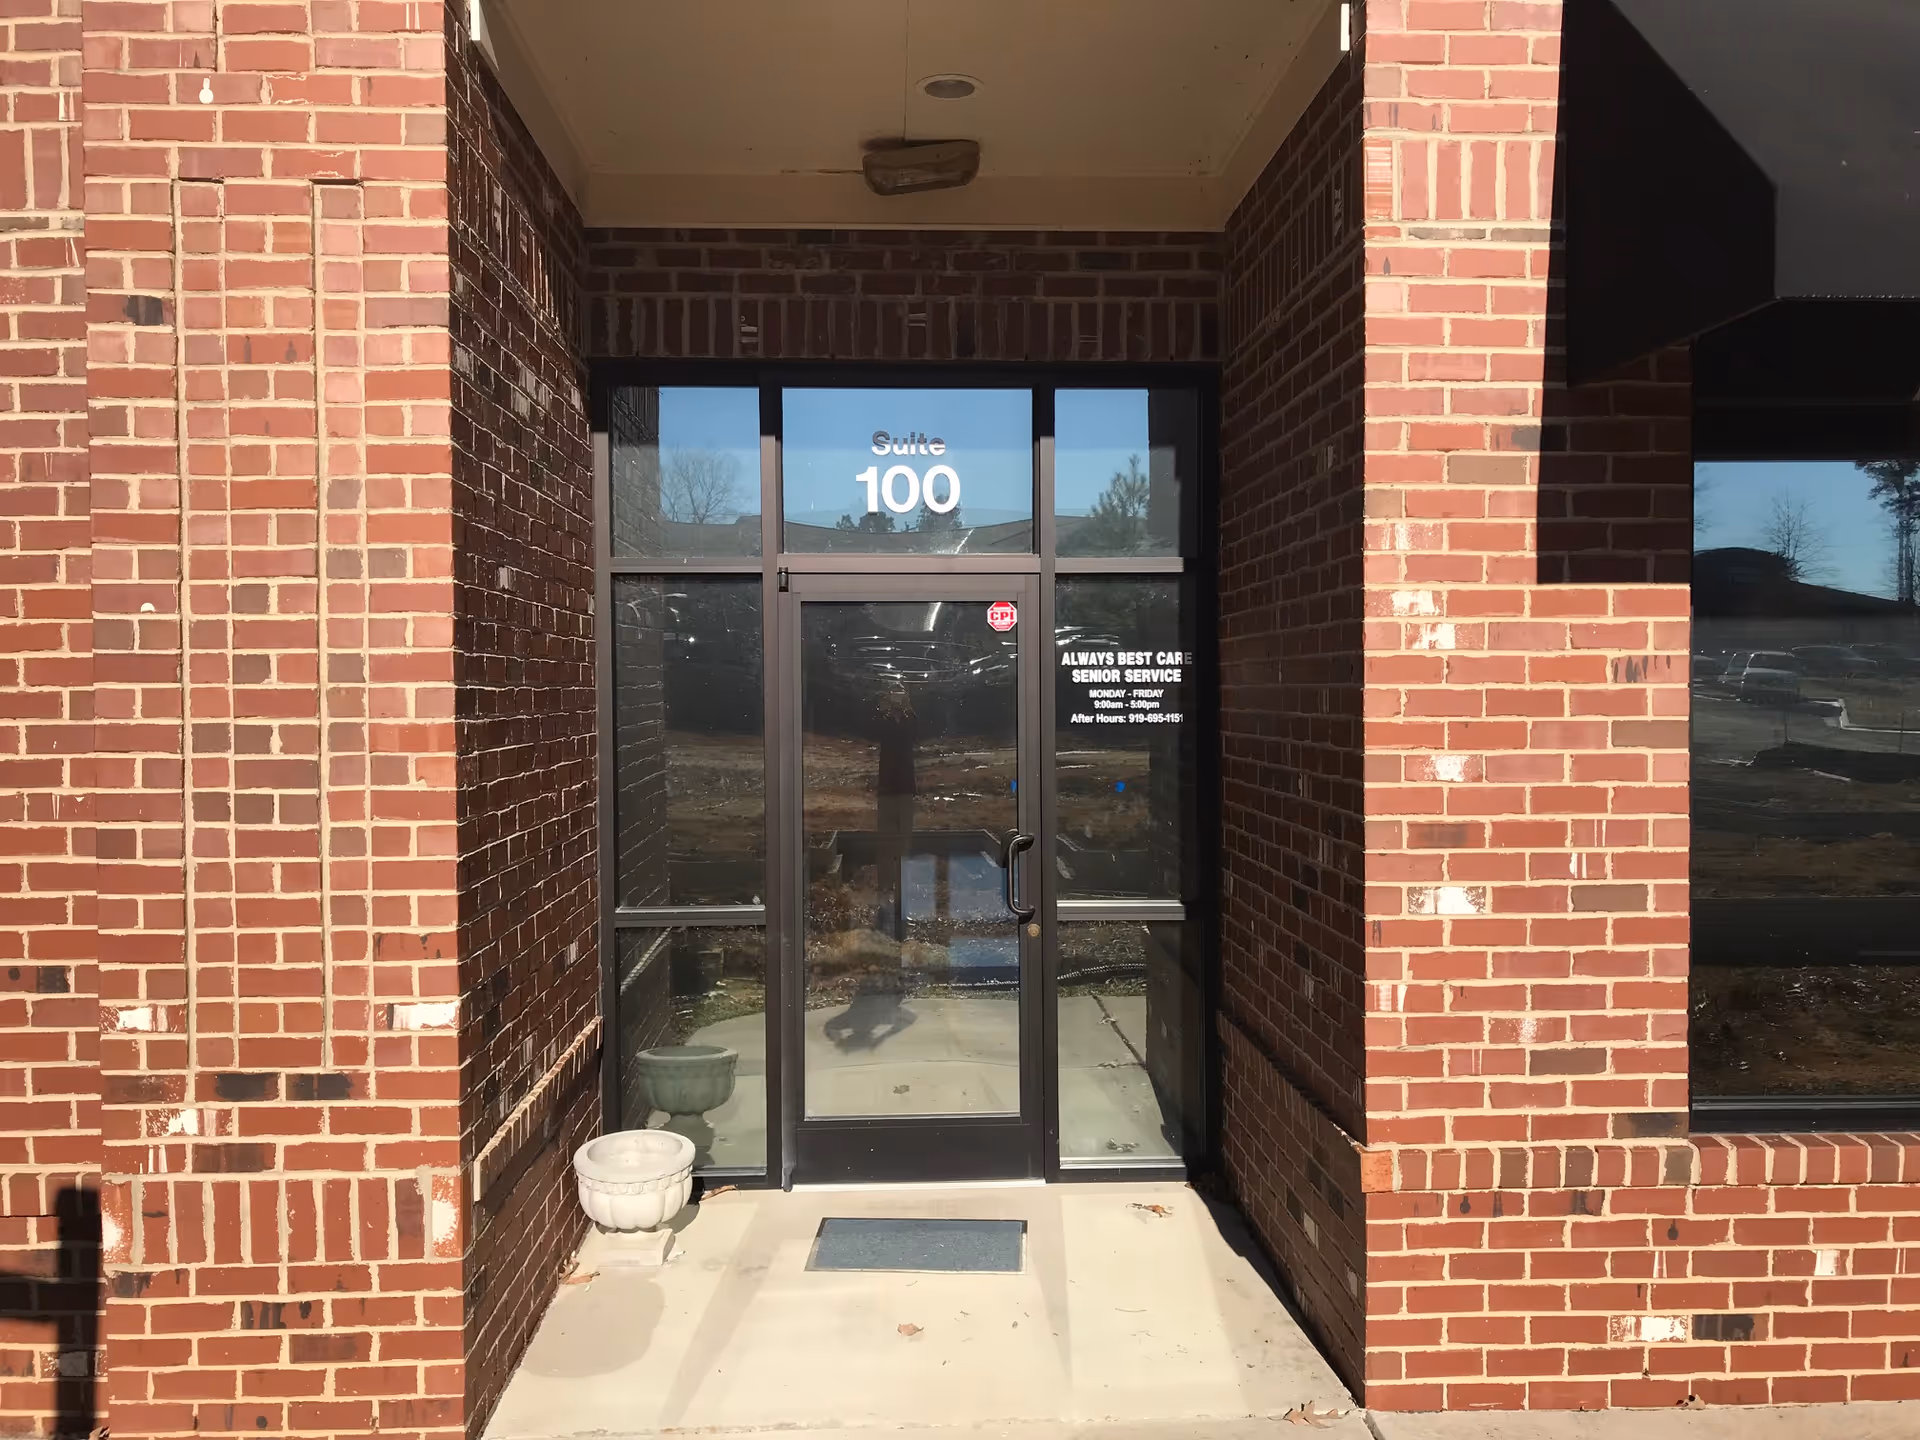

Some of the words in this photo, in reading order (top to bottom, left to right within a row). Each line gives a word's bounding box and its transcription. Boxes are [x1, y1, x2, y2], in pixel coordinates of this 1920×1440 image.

[872, 431, 946, 456] Suite
[856, 465, 960, 514] 100
[990, 611, 1014, 620] CPI
[1061, 652, 1114, 665] ALWAYS
[1117, 652, 1152, 665] BEST
[1157, 652, 1192, 665] CARE
[1072, 669, 1120, 683] SENIOR
[1124, 669, 1182, 683] SERVICE
[1089, 689, 1126, 698] MONDAY
[1133, 689, 1164, 698] FRIDAY
[1094, 700, 1123, 709] 9:00am
[1130, 700, 1160, 710] 5:00pm
[1071, 714, 1094, 723] After
[1096, 714, 1126, 723] Hours:
